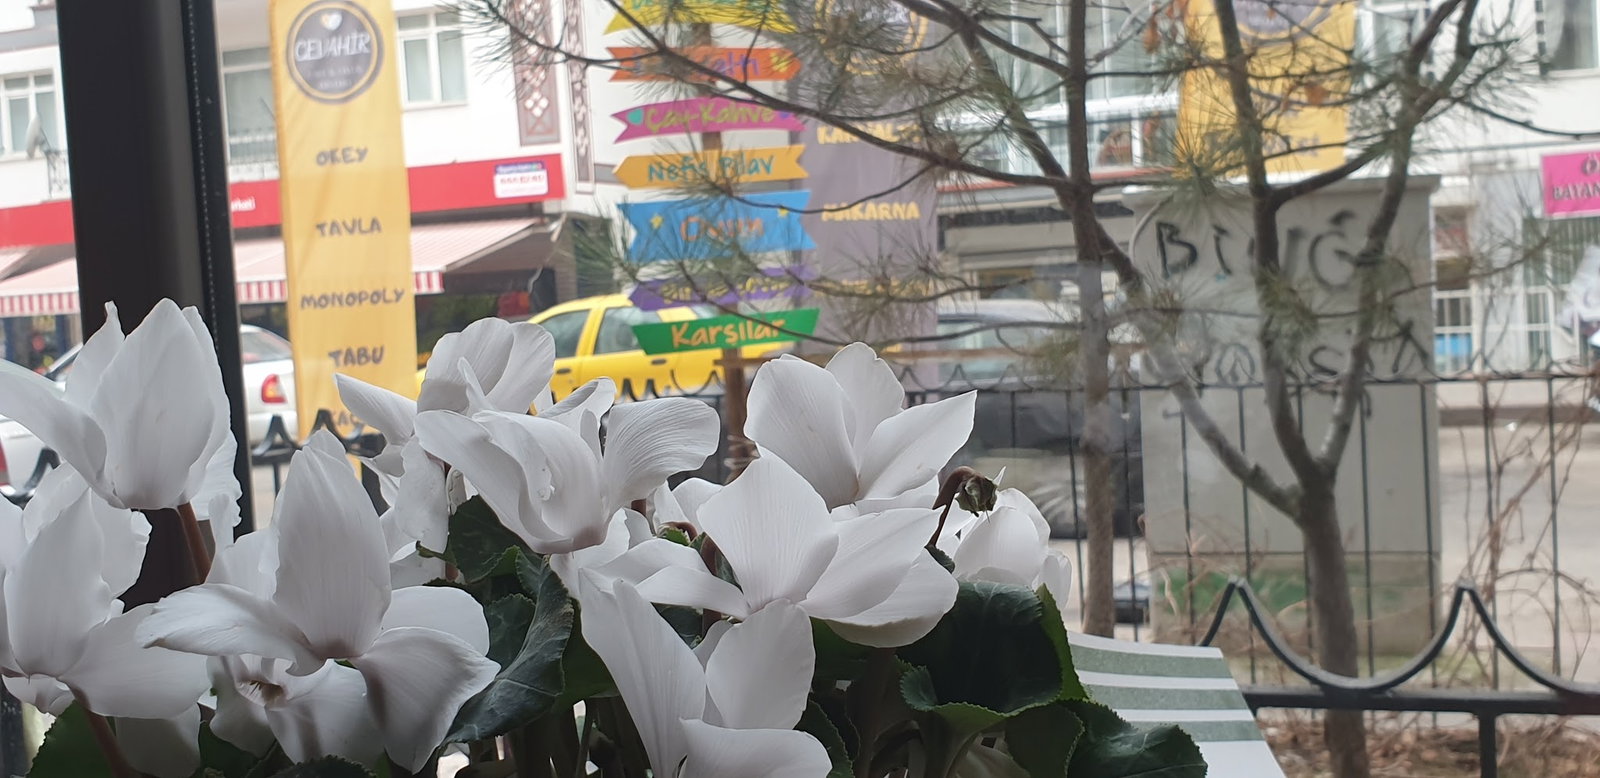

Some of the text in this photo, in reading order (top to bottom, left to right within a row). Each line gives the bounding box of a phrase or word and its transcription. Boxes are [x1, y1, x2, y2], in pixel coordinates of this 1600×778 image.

[315, 147, 368, 167] OKEY
[821, 201, 921, 222] MAKARNA
[315, 216, 382, 238] TAVLA
[300, 288, 406, 312] MONOPOLY
[670, 318, 786, 350] Karşılar
[328, 346, 386, 367] TABU
